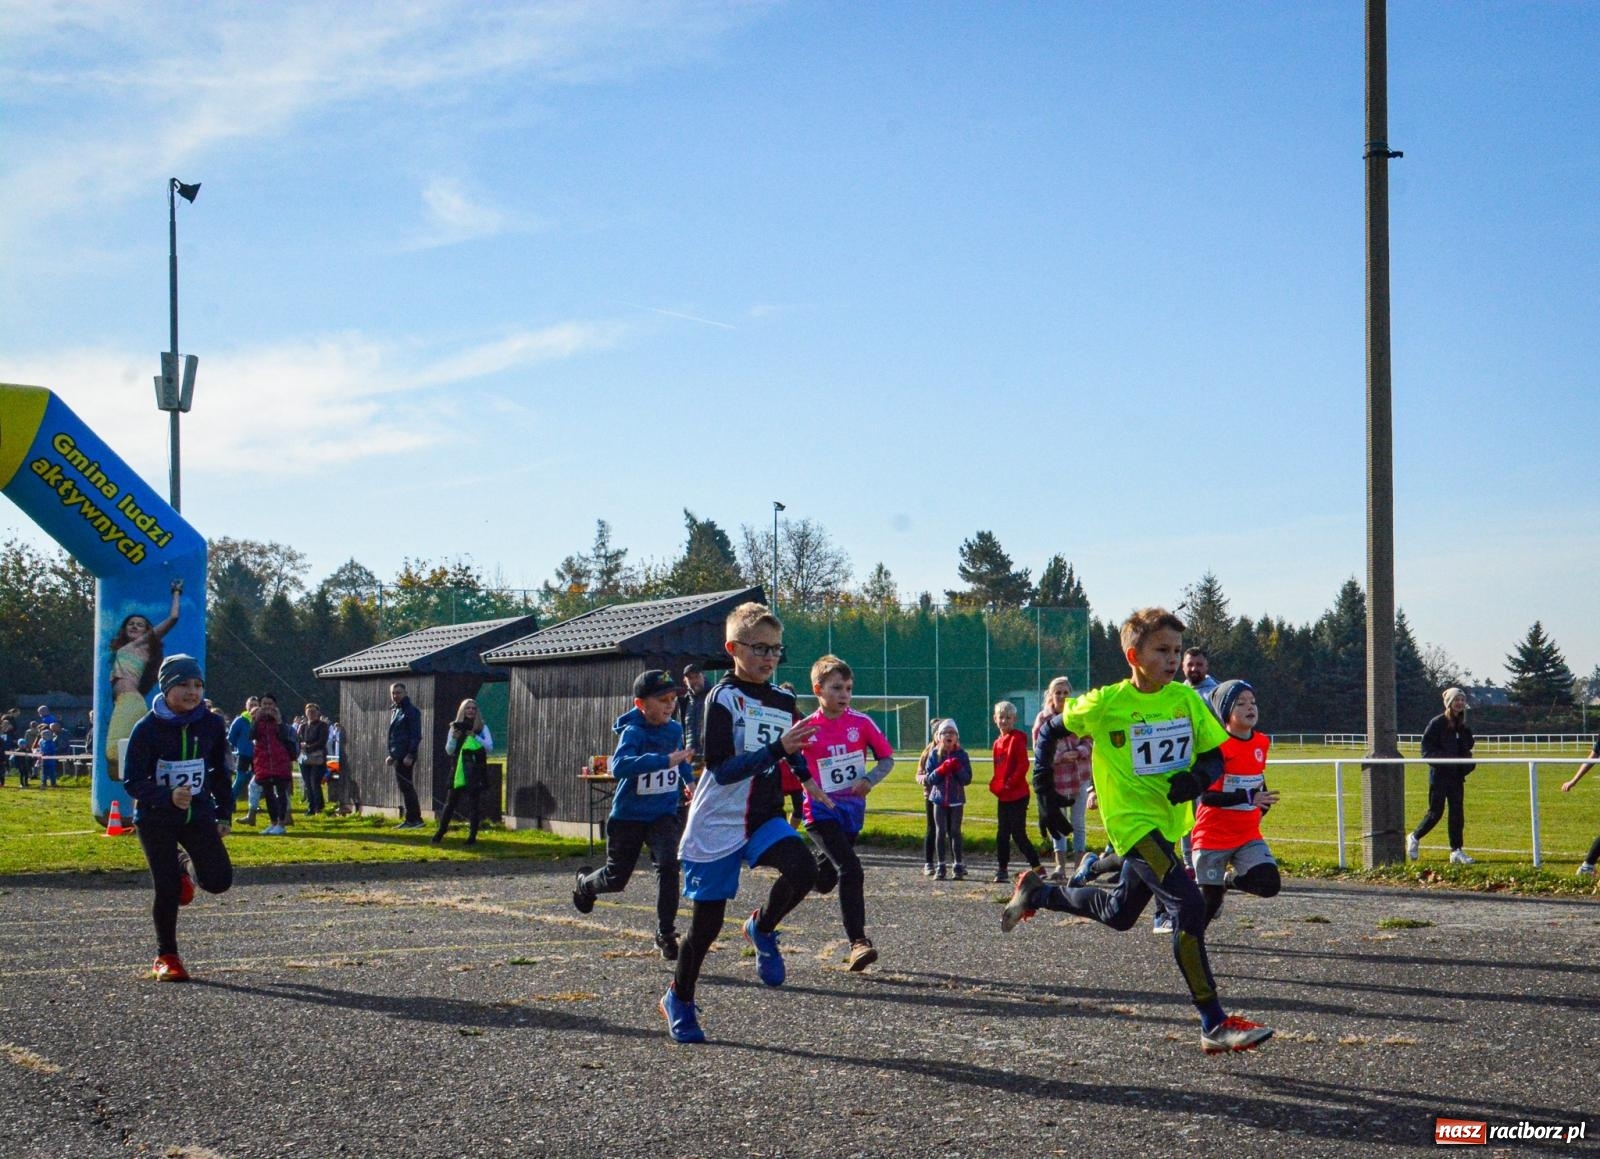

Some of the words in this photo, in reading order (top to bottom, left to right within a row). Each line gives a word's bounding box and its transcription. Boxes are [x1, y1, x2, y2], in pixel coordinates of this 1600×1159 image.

[52, 432, 119, 499] Gmina
[117, 494, 173, 548] ludzi
[30, 457, 148, 565] aktywnych
[756, 723, 785, 745] 57
[1137, 736, 1190, 765] 127
[160, 771, 202, 788] 125
[642, 770, 677, 788] 119
[830, 765, 858, 785] 63
